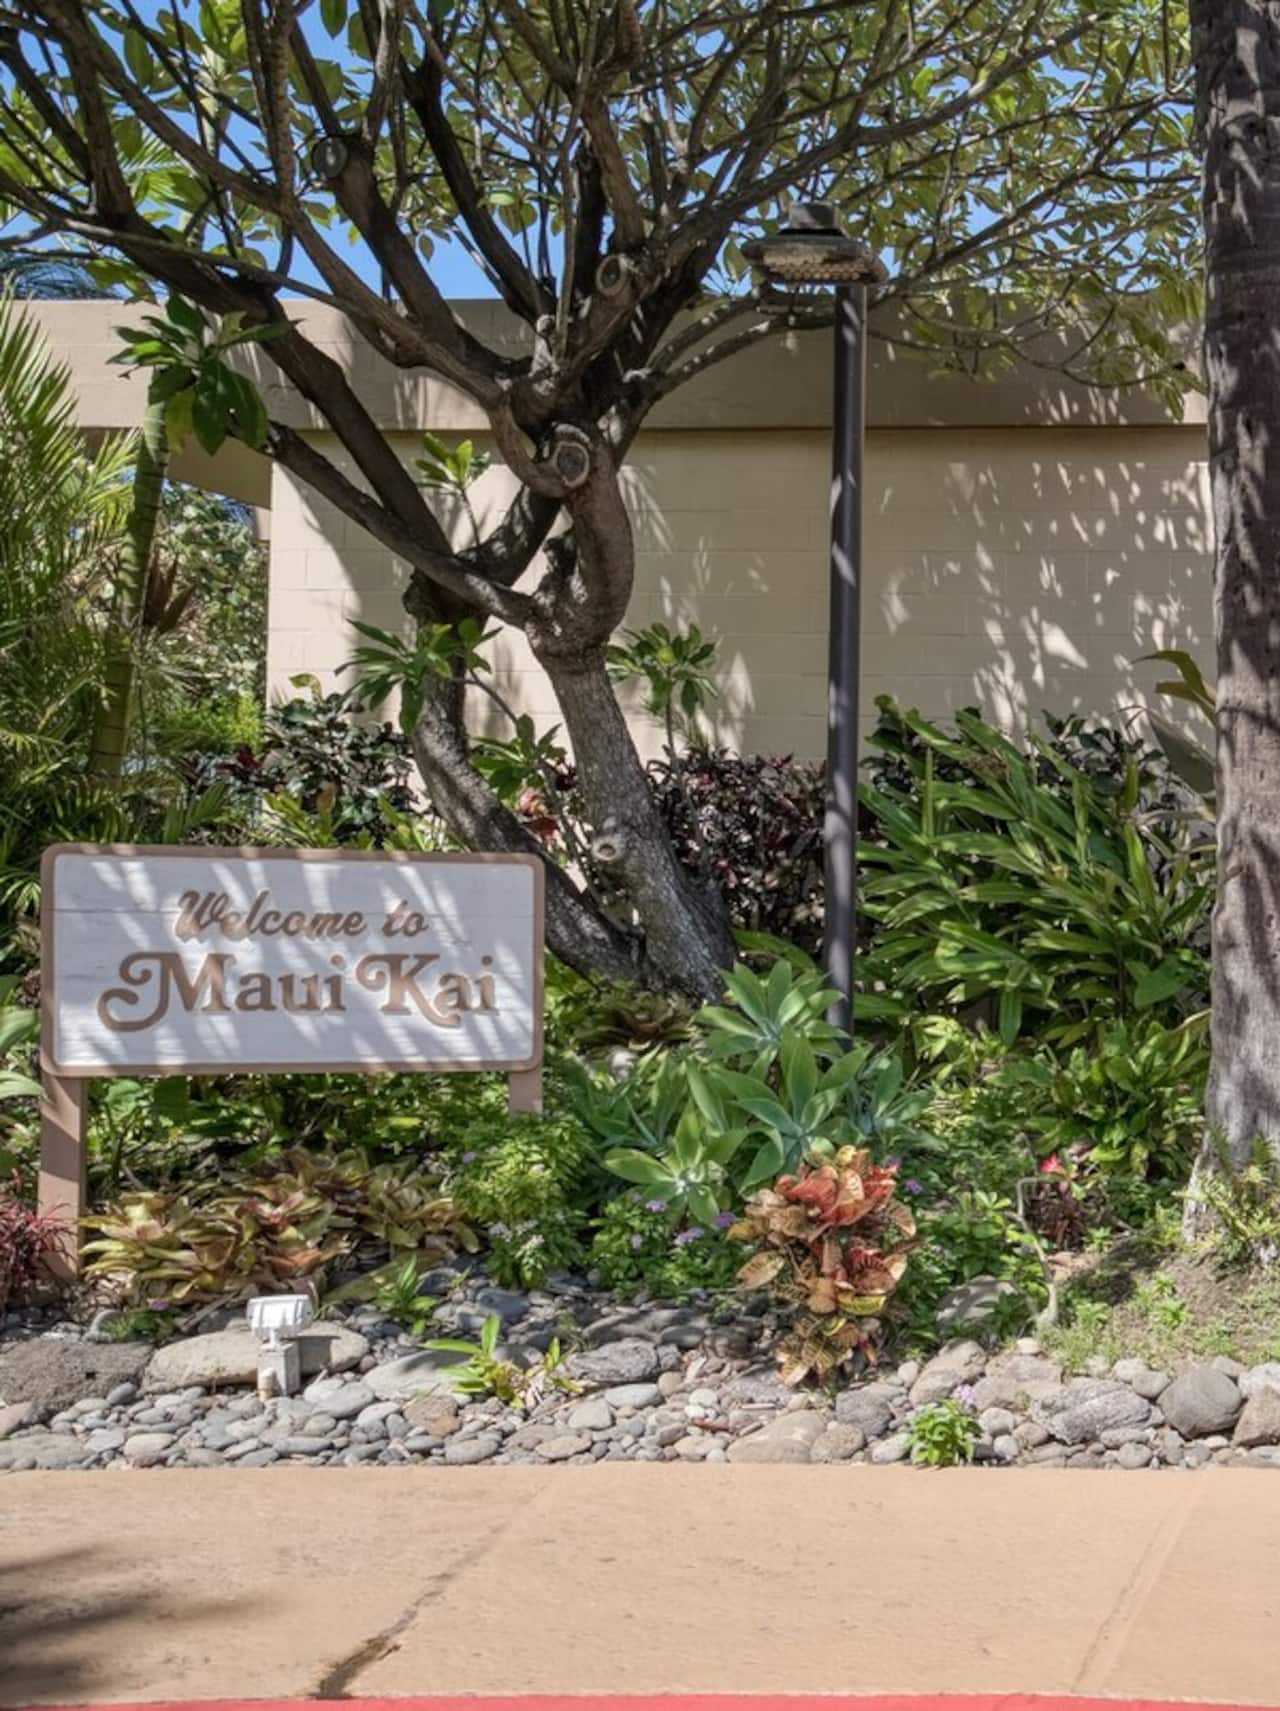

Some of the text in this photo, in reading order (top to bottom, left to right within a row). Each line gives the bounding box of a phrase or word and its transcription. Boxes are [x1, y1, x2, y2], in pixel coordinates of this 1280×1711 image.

[174, 889, 429, 944] Welcome to
[97, 951, 500, 1032] Maui Kai
